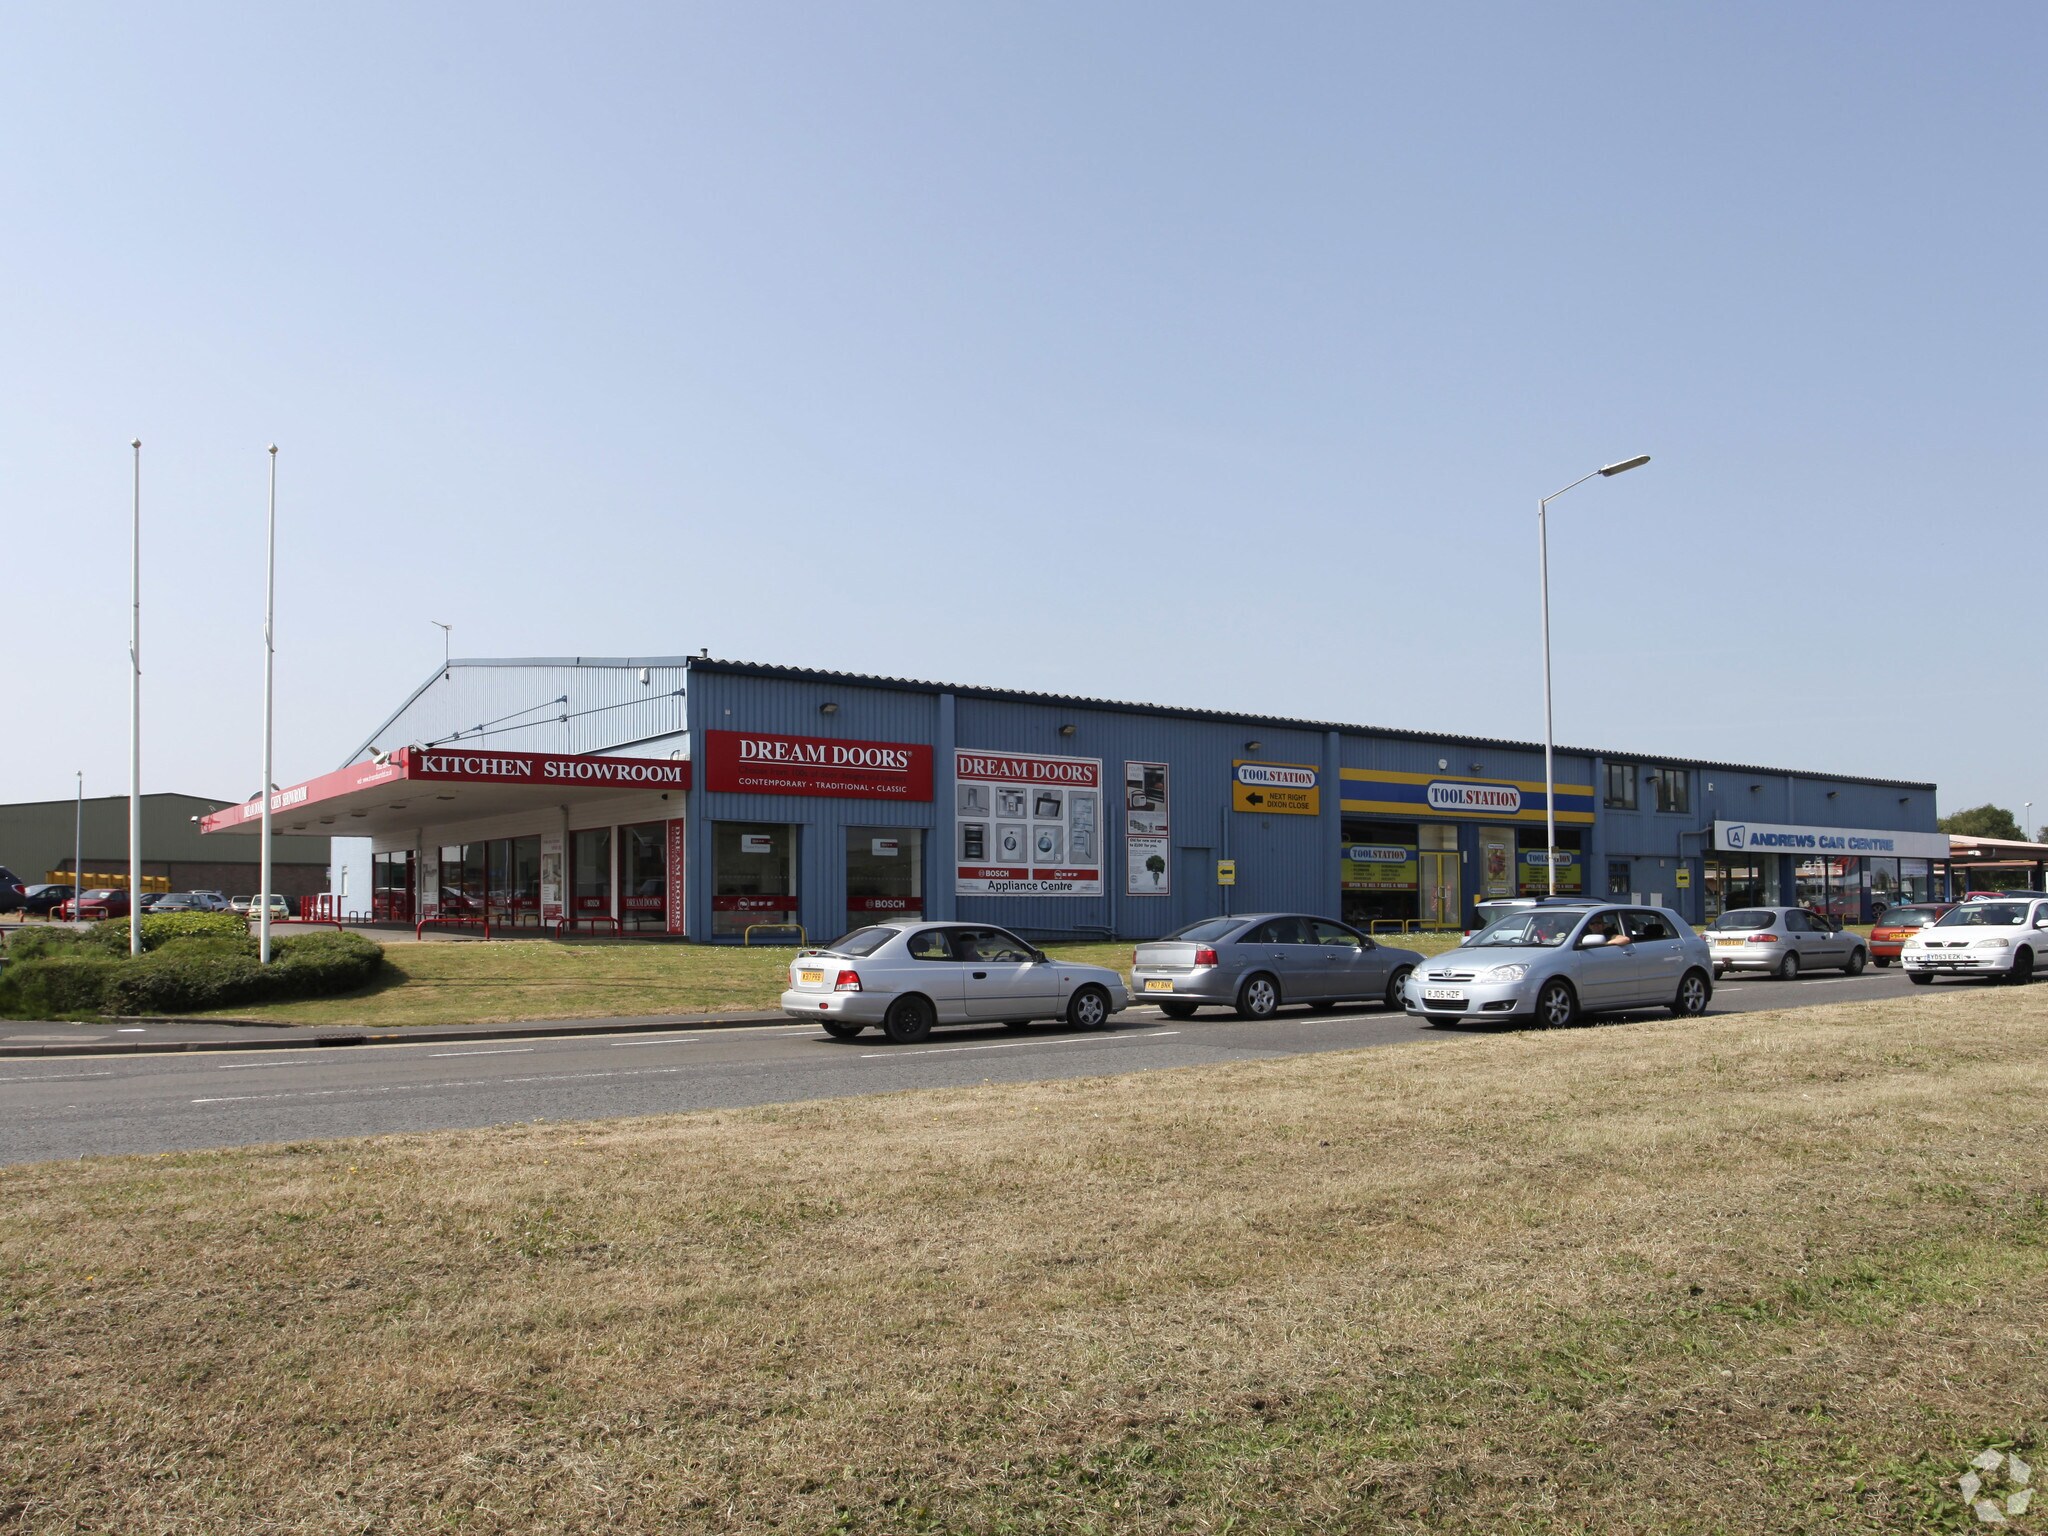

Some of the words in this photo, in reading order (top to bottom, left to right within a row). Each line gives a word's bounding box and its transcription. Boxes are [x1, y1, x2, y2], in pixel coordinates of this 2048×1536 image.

[740, 740, 826, 762] DREAM
[832, 746, 908, 768] DOORS
[420, 756, 532, 776] KITCHEN
[544, 762, 682, 782] SHOWROOM
[959, 758, 1028, 777] DREAM
[1033, 763, 1093, 782] DOORS
[1242, 769, 1312, 784] TOOLSTATION
[739, 778, 806, 788] CONTEMPORARY
[816, 782, 868, 791] TRADITIONAL
[1432, 788, 1517, 807] TOOLSTATION
[1750, 832, 1815, 848] ANDREWS
[1819, 835, 1845, 849] CAR
[1848, 836, 1894, 850] CENTRE
[1352, 849, 1405, 859] TOOLSTATION
[988, 881, 1038, 892] Appliance
[1041, 881, 1073, 890] Centre
[875, 900, 905, 908] BOSCH
